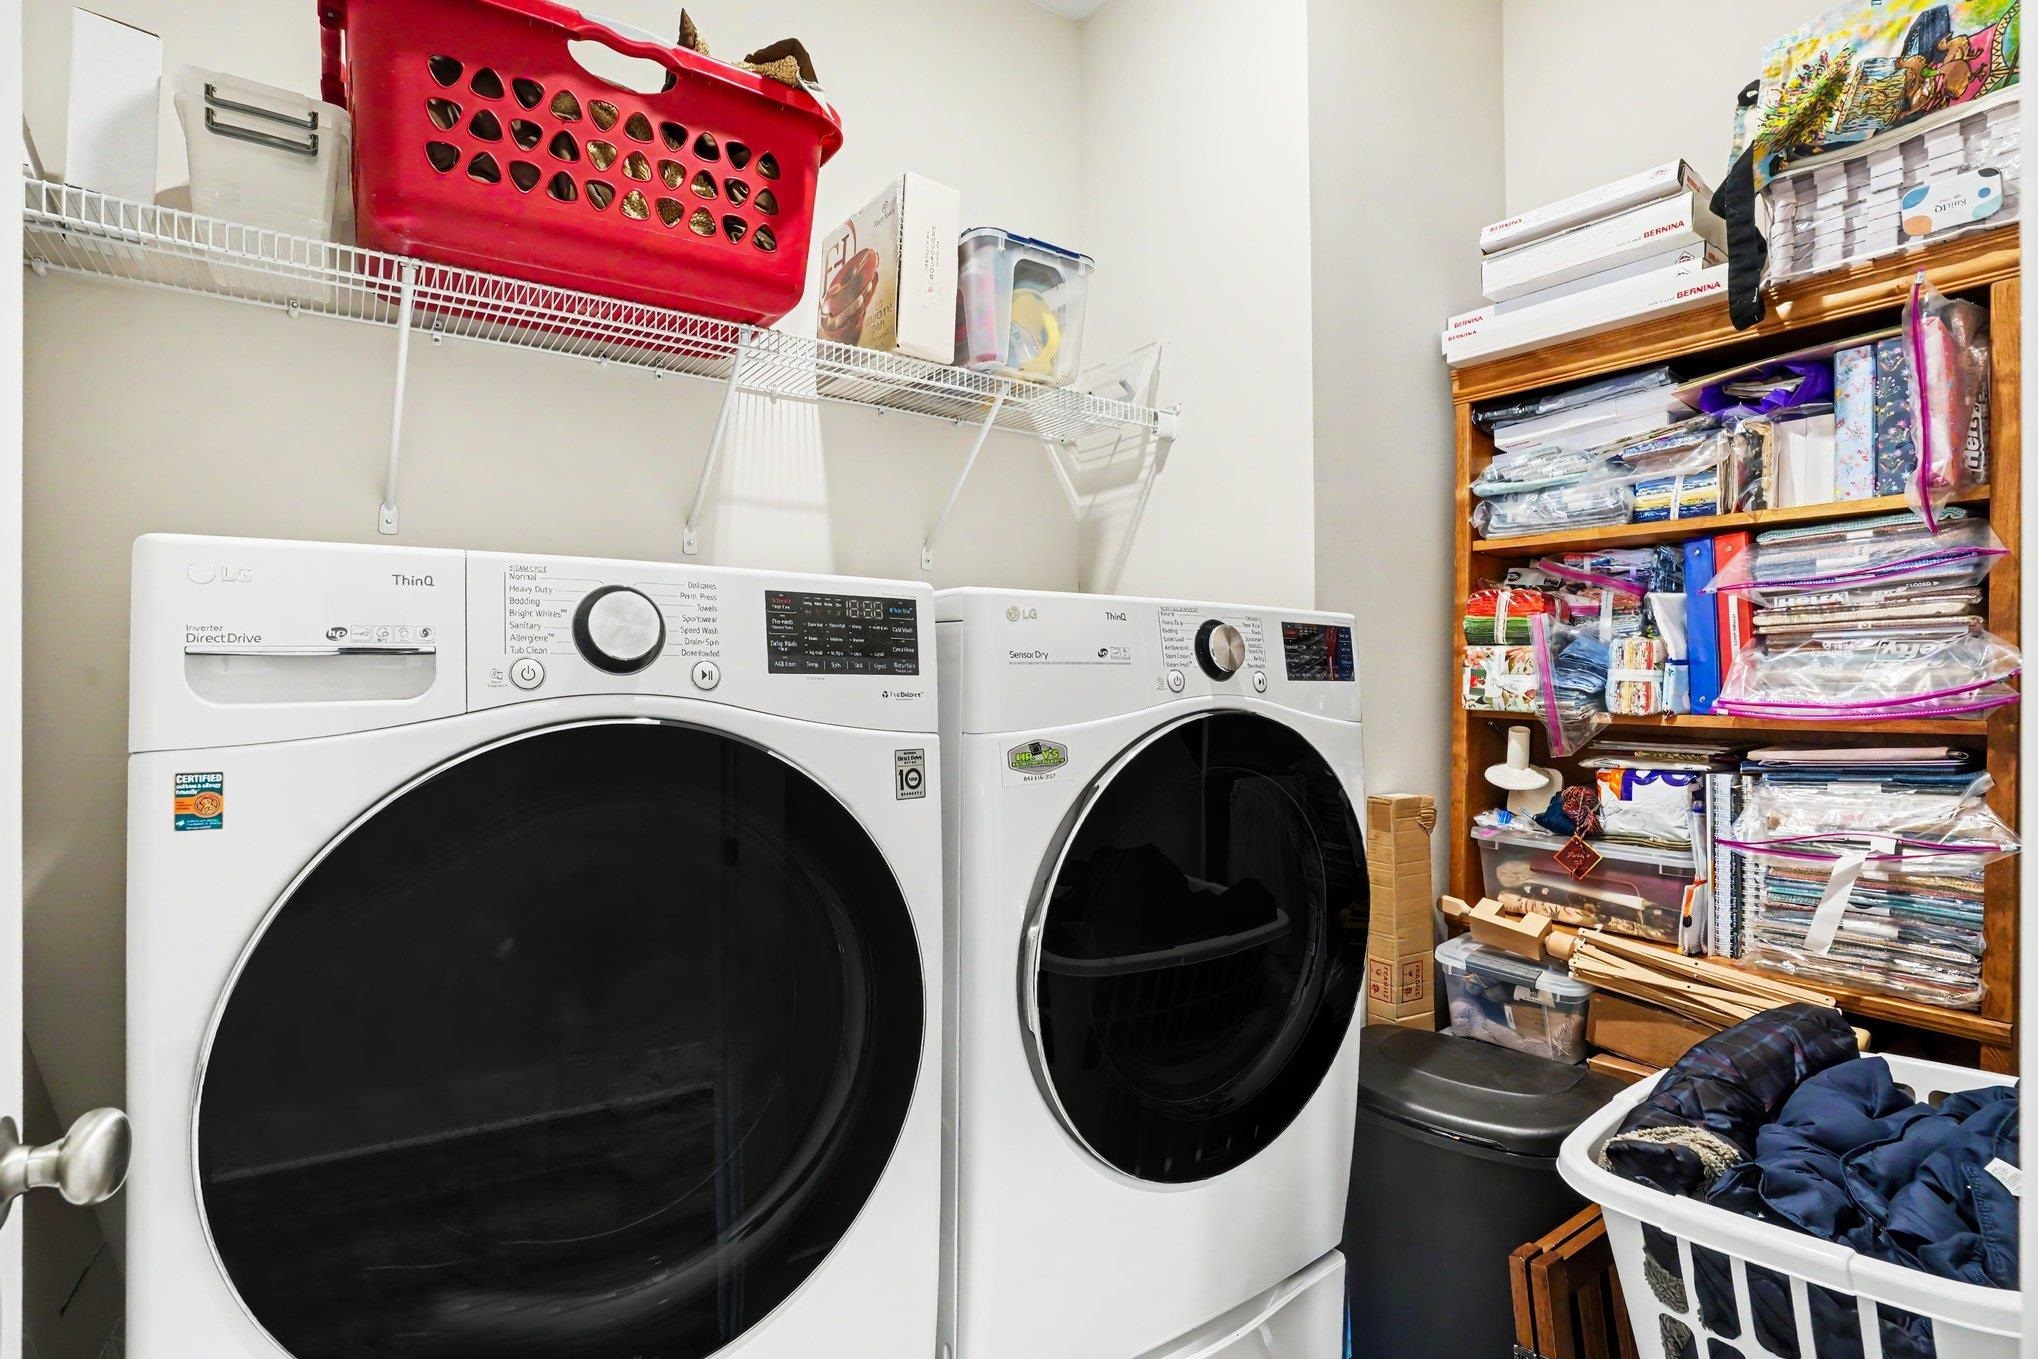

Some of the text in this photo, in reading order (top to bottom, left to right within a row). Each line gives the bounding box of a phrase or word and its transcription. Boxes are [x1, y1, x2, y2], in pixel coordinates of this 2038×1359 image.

[1643, 220, 1685, 239] BERNINA
[1676, 281, 1721, 300] BERNINA
[1454, 316, 1483, 329] BERNINA
[392, 574, 435, 588] ThinQ
[509, 571, 537, 581] Normal
[509, 584, 553, 596] Heavy Duty
[509, 608, 533, 619] Bright
[1022, 608, 1038, 620] LG
[1105, 611, 1127, 622] ThinQ
[186, 624, 224, 633] Inverter
[509, 621, 541, 631] Sanitary
[509, 645, 548, 655] Tub Clean
[1009, 650, 1049, 661] Sensor Dry
[176, 774, 223, 783] CERTIFIED
[898, 768, 922, 791] 10
